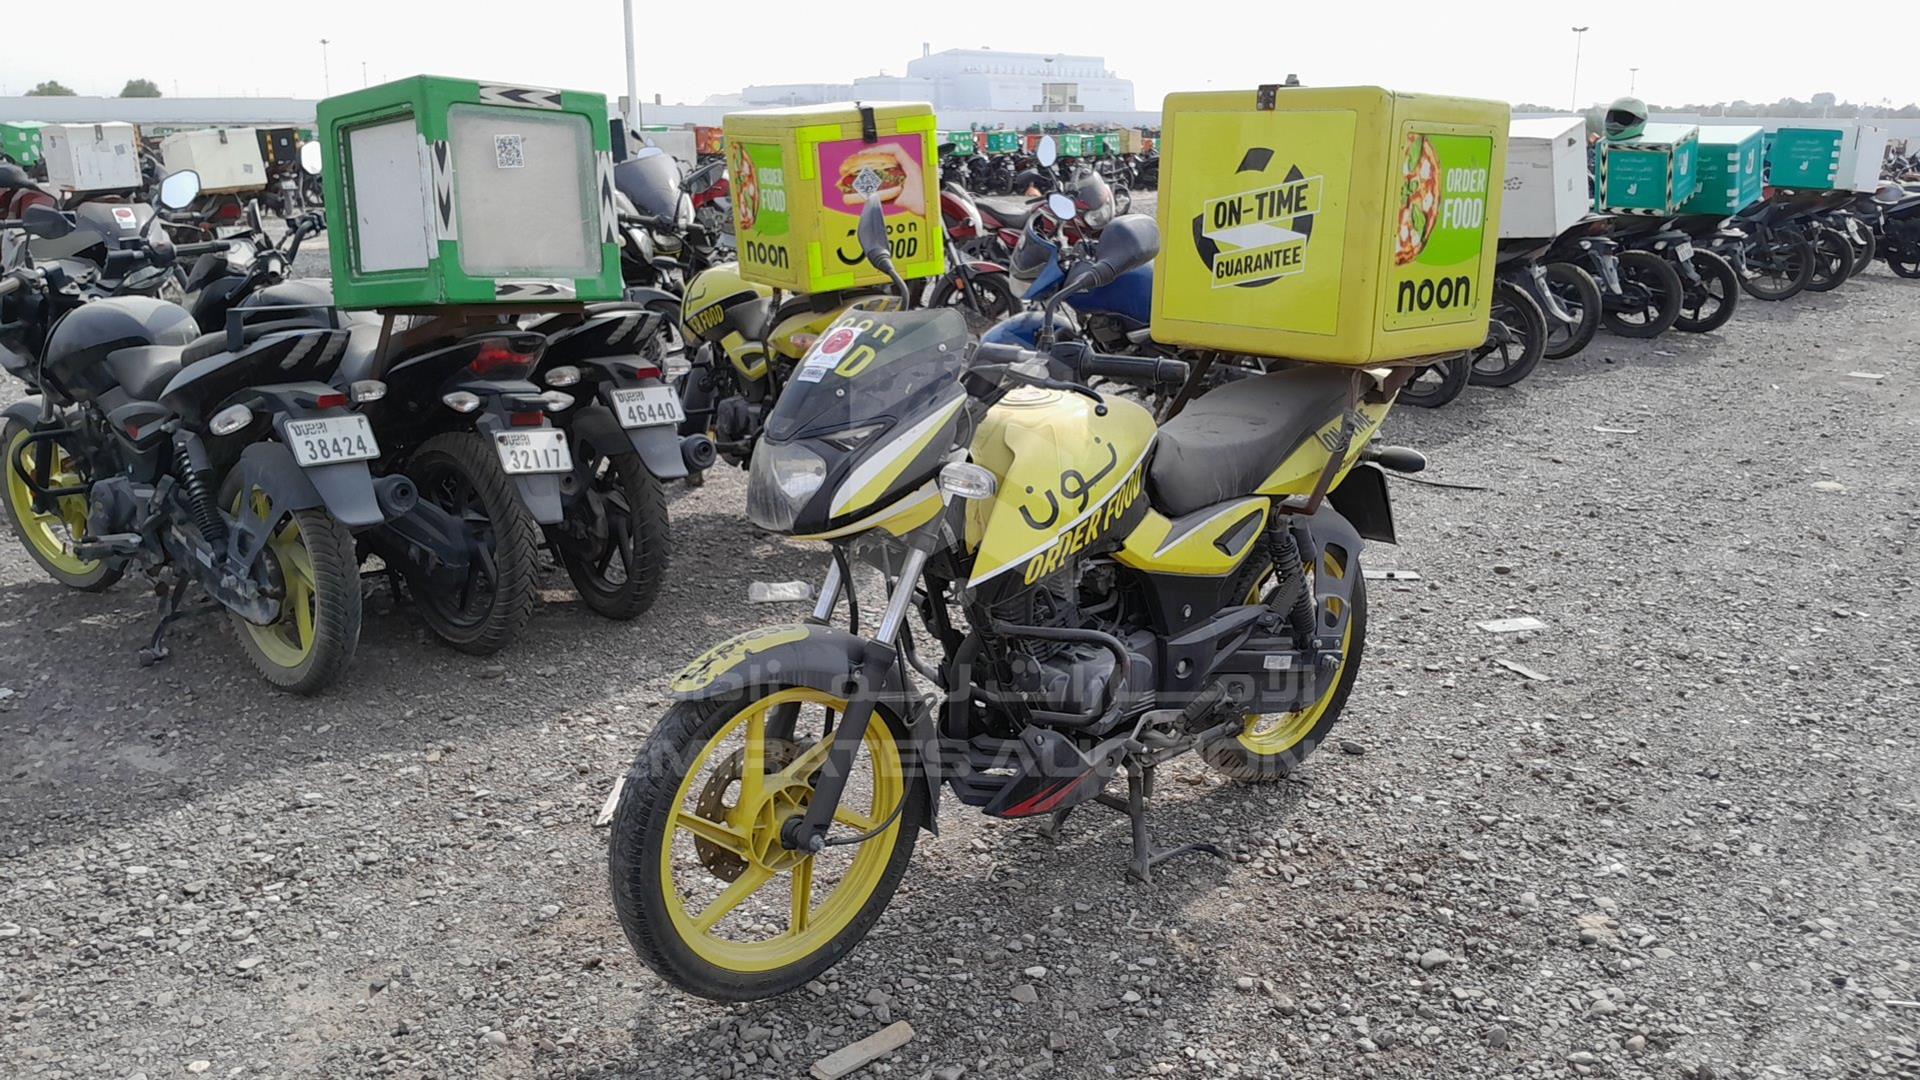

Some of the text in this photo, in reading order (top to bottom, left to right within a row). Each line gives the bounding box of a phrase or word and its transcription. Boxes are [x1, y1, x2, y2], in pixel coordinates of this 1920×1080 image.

[1446, 167, 1487, 193] ORDER
[760, 188, 786, 213] FOOD
[1213, 183, 1309, 229] ON-TIME
[1442, 197, 1483, 230] FOOD
[746, 240, 789, 269] noon
[1215, 245, 1302, 280] GUARANTEE
[1396, 275, 1471, 313] noon
[699, 303, 725, 331] FOOD
[628, 402, 676, 423] 46440
[304, 435, 368, 460] 38424
[510, 448, 561, 470] 32117
[1018, 436, 1118, 531] نون
[1024, 463, 1143, 586] ORDER FOOD
